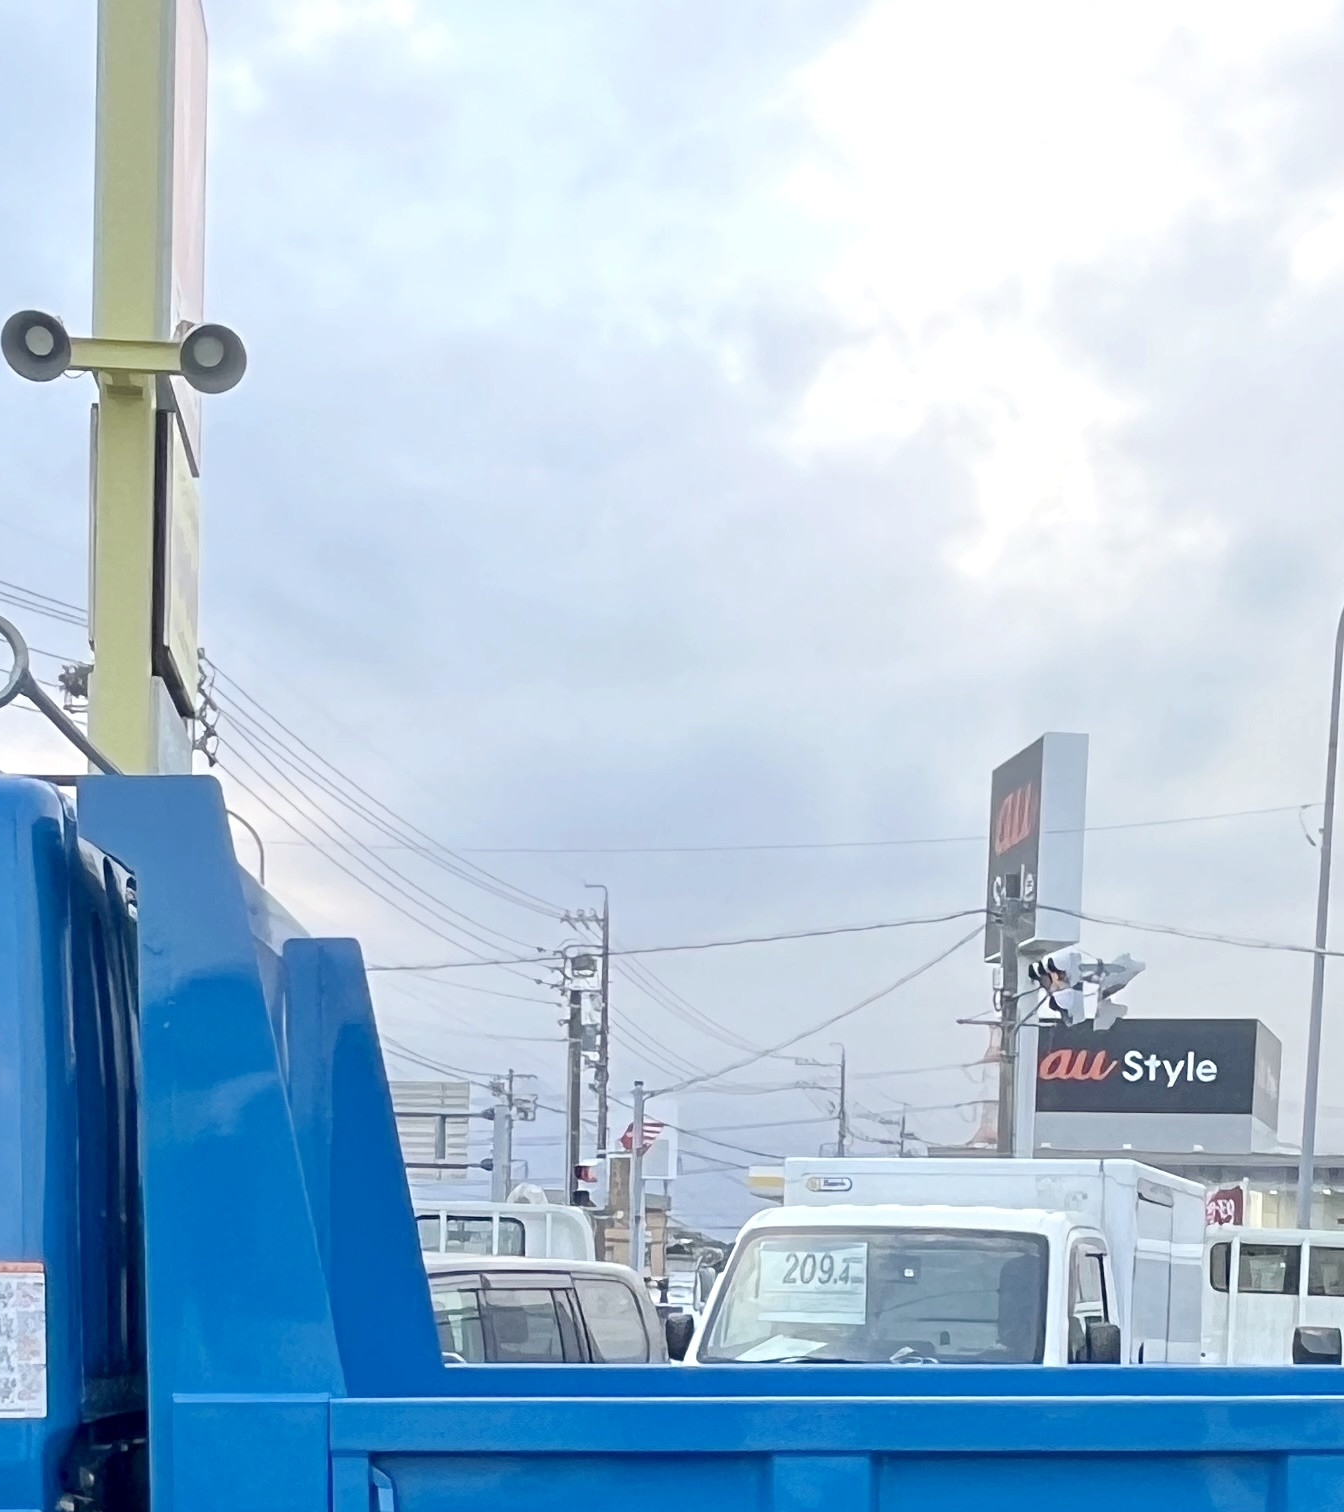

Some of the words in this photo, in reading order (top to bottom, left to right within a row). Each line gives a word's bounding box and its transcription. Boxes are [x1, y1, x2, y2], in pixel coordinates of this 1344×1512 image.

[995, 782, 1033, 856] au
[1039, 1049, 1118, 1080] au
[1122, 1051, 1218, 1088] Style
[783, 1252, 850, 1284] 209.4
